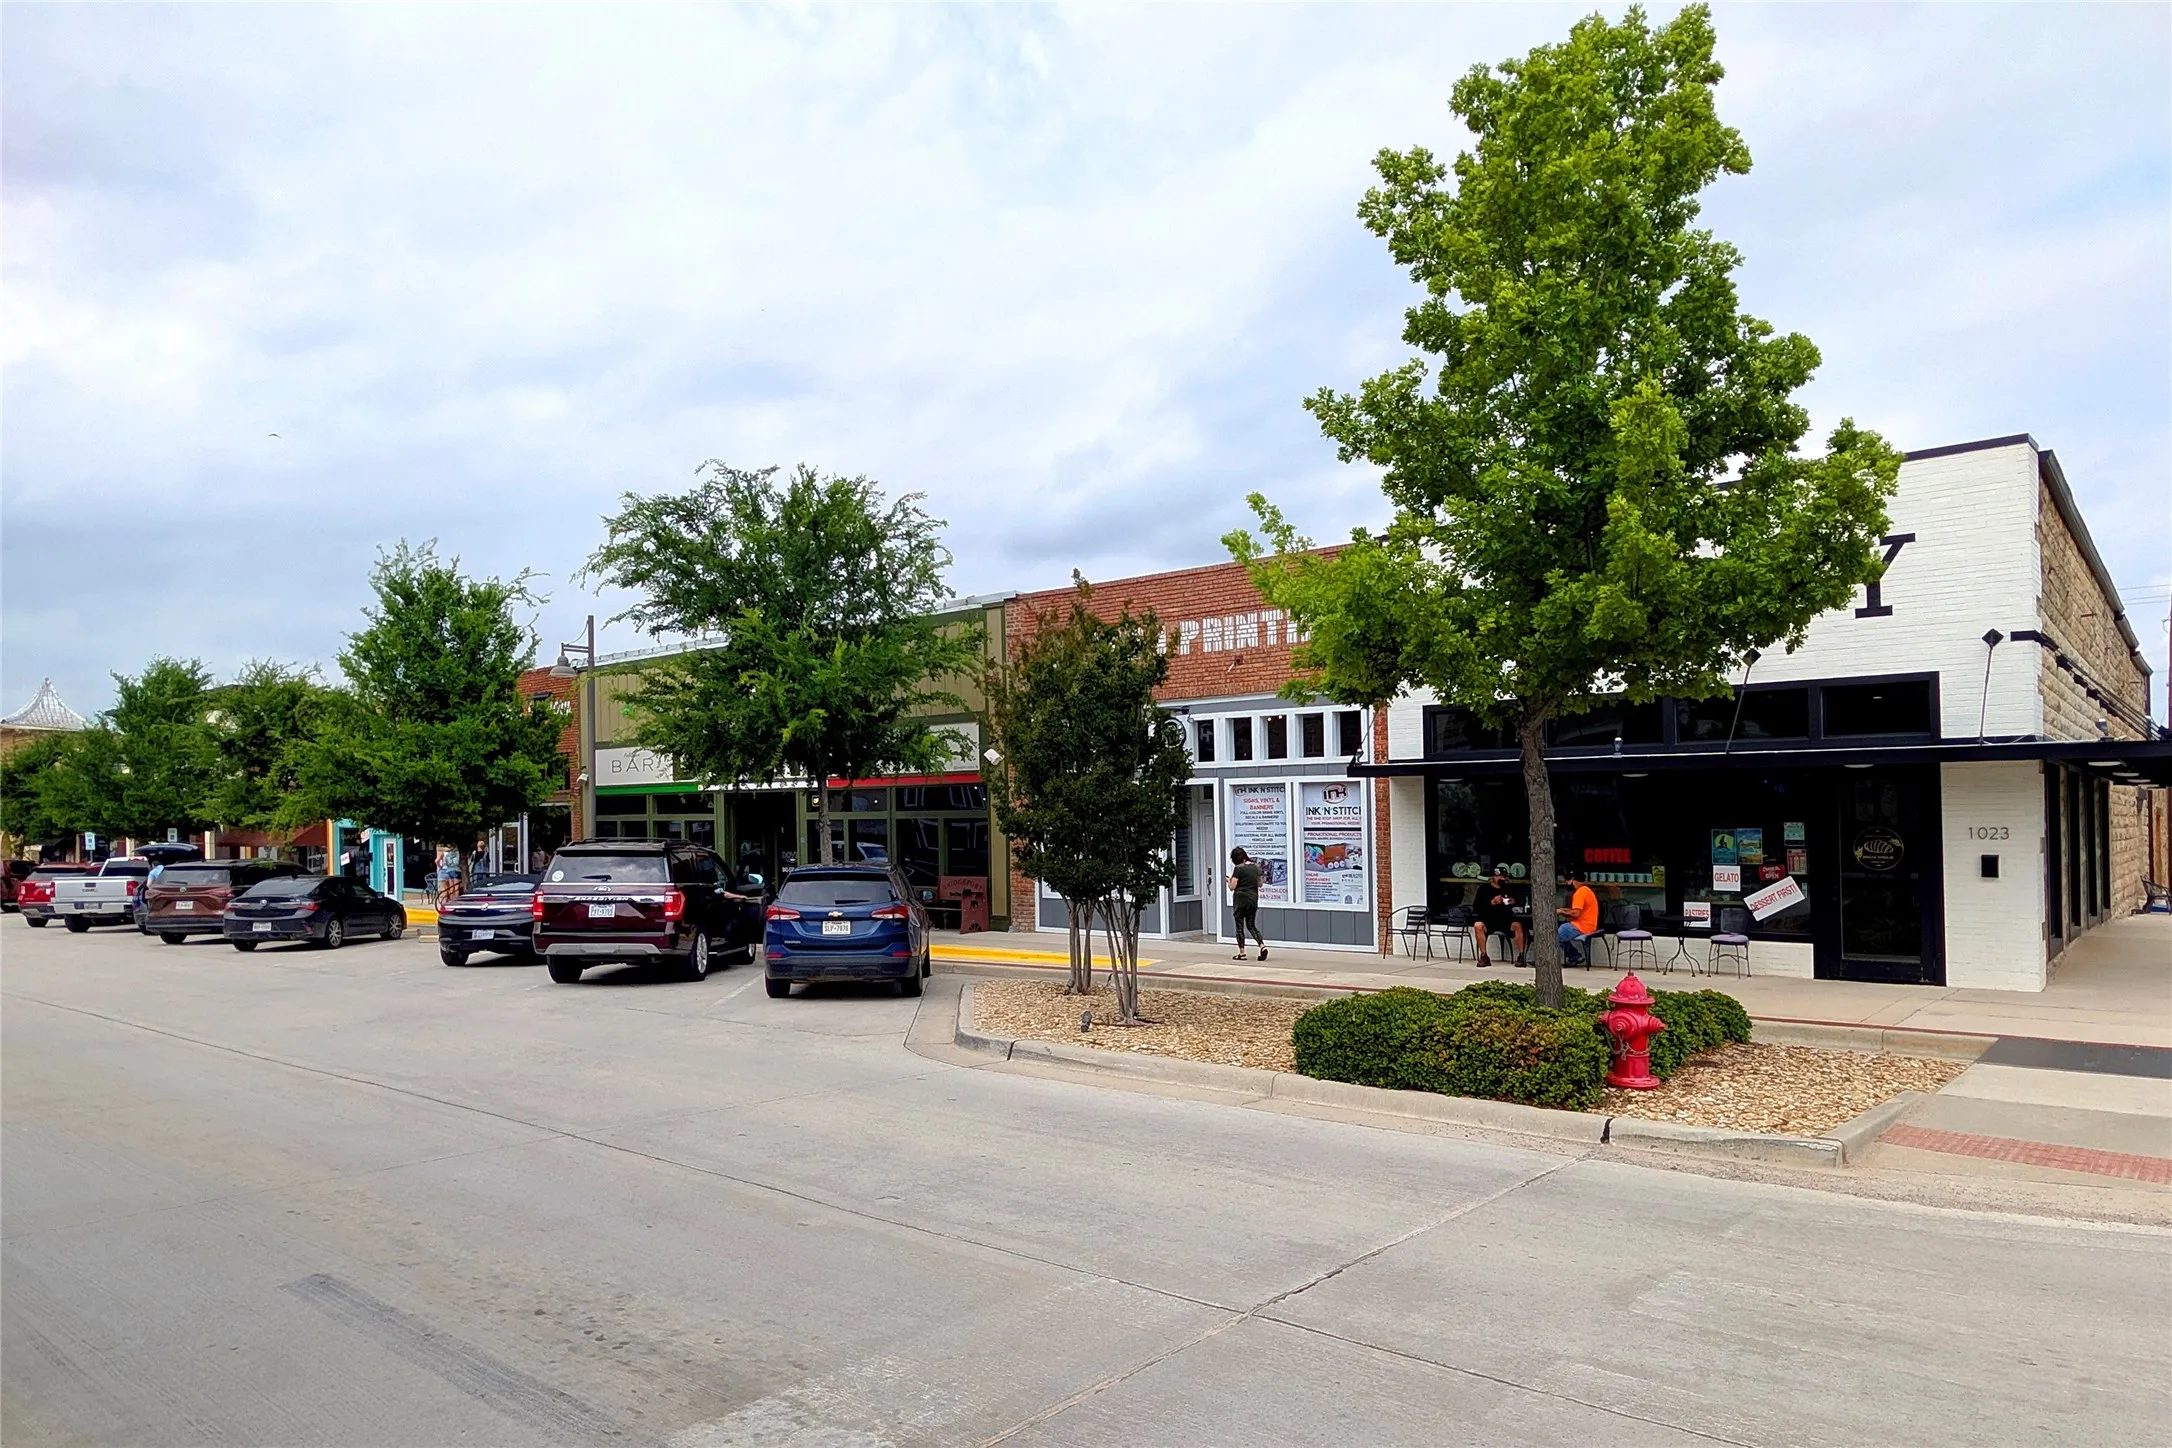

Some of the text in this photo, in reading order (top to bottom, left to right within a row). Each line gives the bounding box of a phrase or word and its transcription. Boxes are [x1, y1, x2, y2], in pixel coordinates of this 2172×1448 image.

[1306, 806, 1321, 815] INK
[1968, 827, 2010, 840] 1023
[1584, 848, 1631, 863] COFFEE
[1715, 873, 1739, 883] GELATO
[1749, 893, 1777, 912] DESSERT
